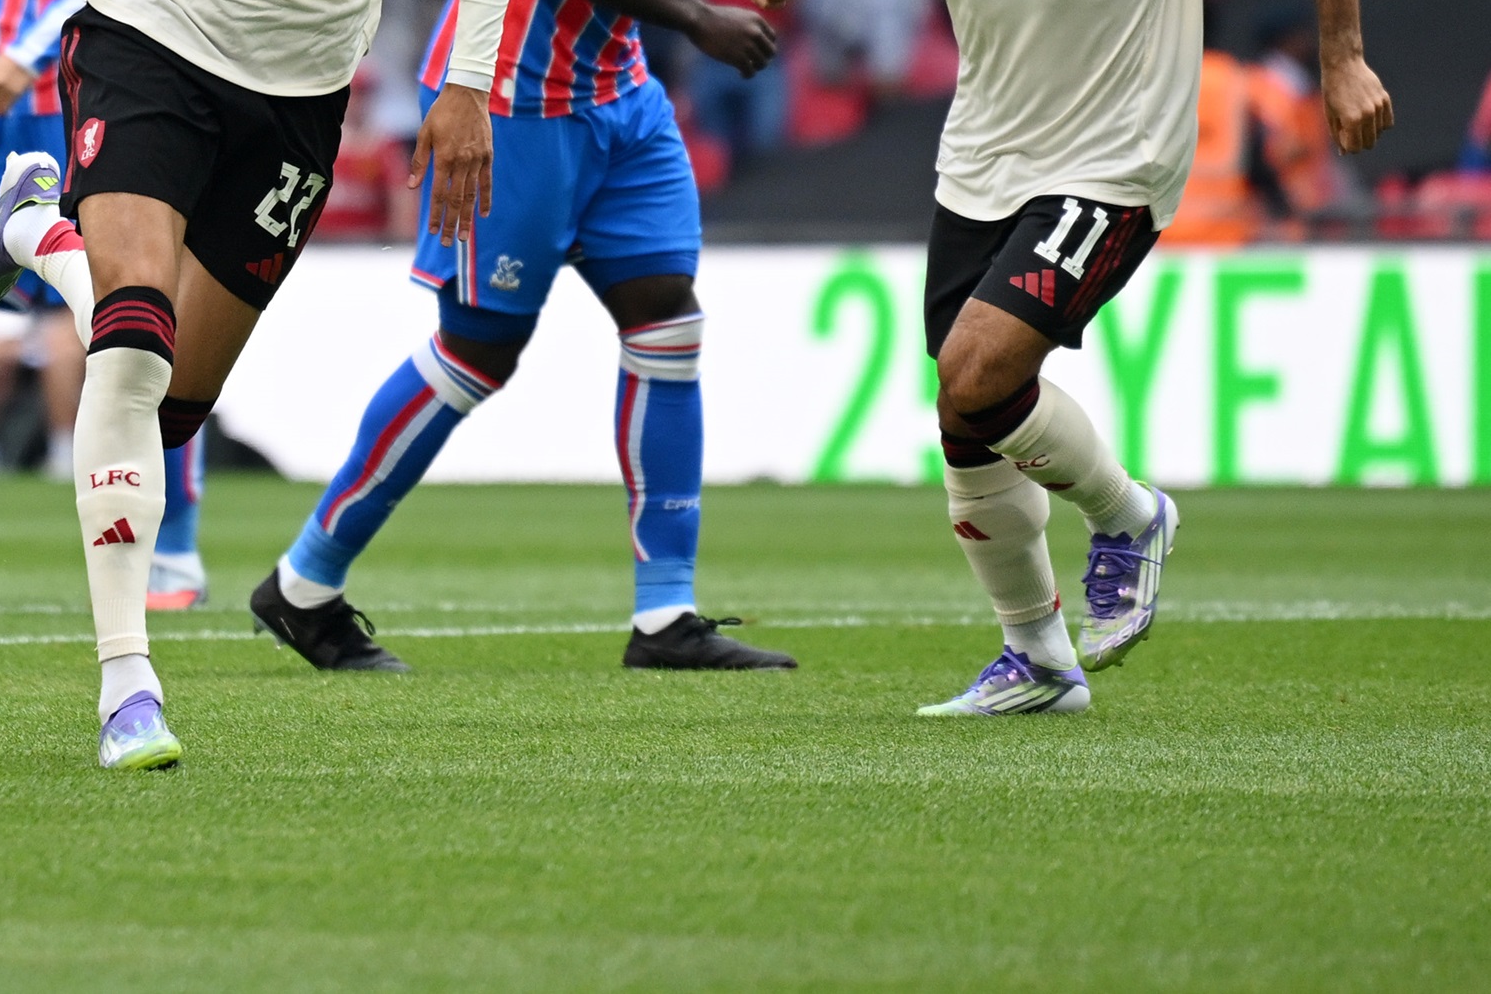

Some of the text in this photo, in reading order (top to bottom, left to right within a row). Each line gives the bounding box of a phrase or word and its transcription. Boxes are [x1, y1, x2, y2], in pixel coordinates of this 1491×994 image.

[253, 161, 327, 248] 22
[1033, 197, 1110, 281] 11
[1096, 251, 1491, 485] YEA
[89, 469, 141, 490] LFC
[1014, 453, 1051, 472] FC
